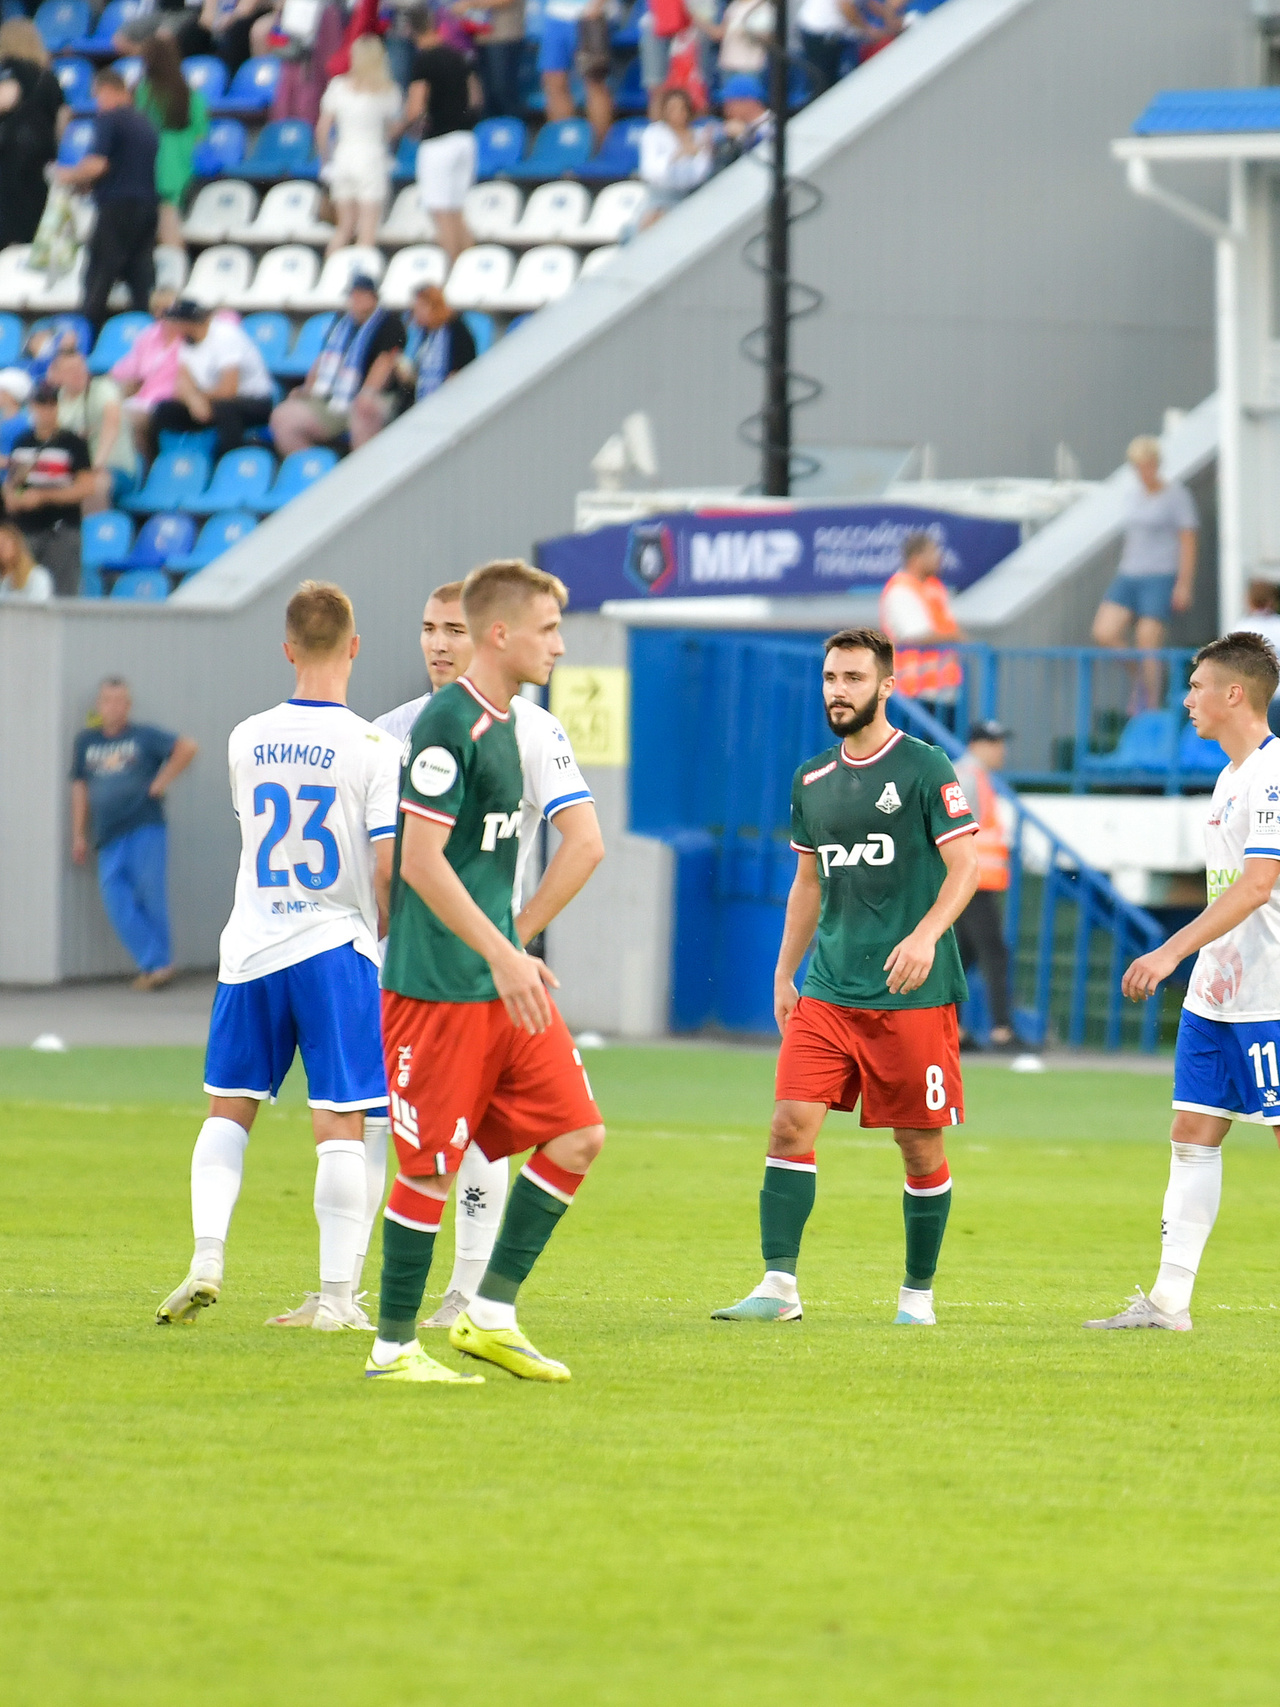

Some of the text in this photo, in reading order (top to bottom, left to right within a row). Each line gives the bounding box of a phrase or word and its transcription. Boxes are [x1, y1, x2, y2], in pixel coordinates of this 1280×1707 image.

[691, 529, 801, 581] МИР
[253, 743, 336, 770] ЯКИМОВ
[254, 781, 340, 890] 23
[926, 1064, 946, 1111] 8
[1248, 1041, 1280, 1088] 11
